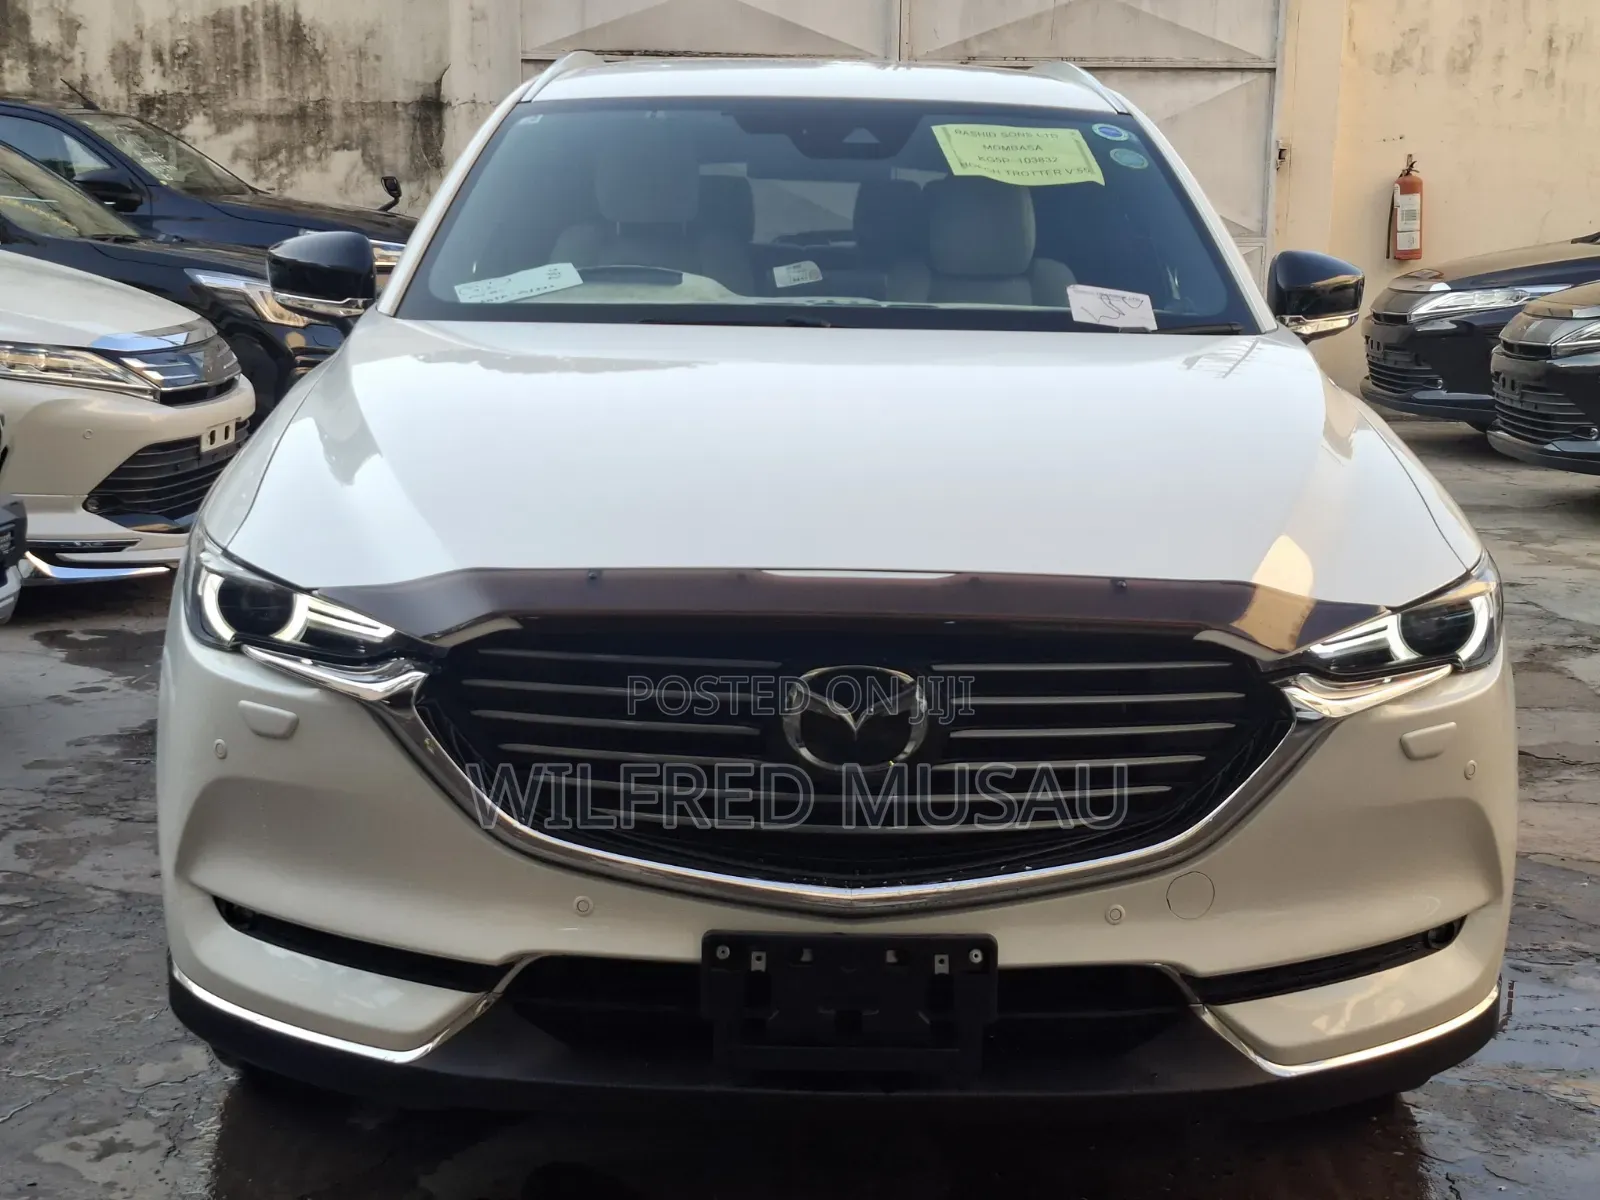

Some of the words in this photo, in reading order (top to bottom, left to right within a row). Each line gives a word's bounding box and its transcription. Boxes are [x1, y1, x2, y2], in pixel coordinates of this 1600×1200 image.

[953, 128, 997, 139] RASHID
[1000, 130, 1034, 139] SONS
[1036, 132, 1060, 140] LTD
[982, 143, 1044, 152] MOMBASA
[1005, 167, 1062, 177] TROTTER
